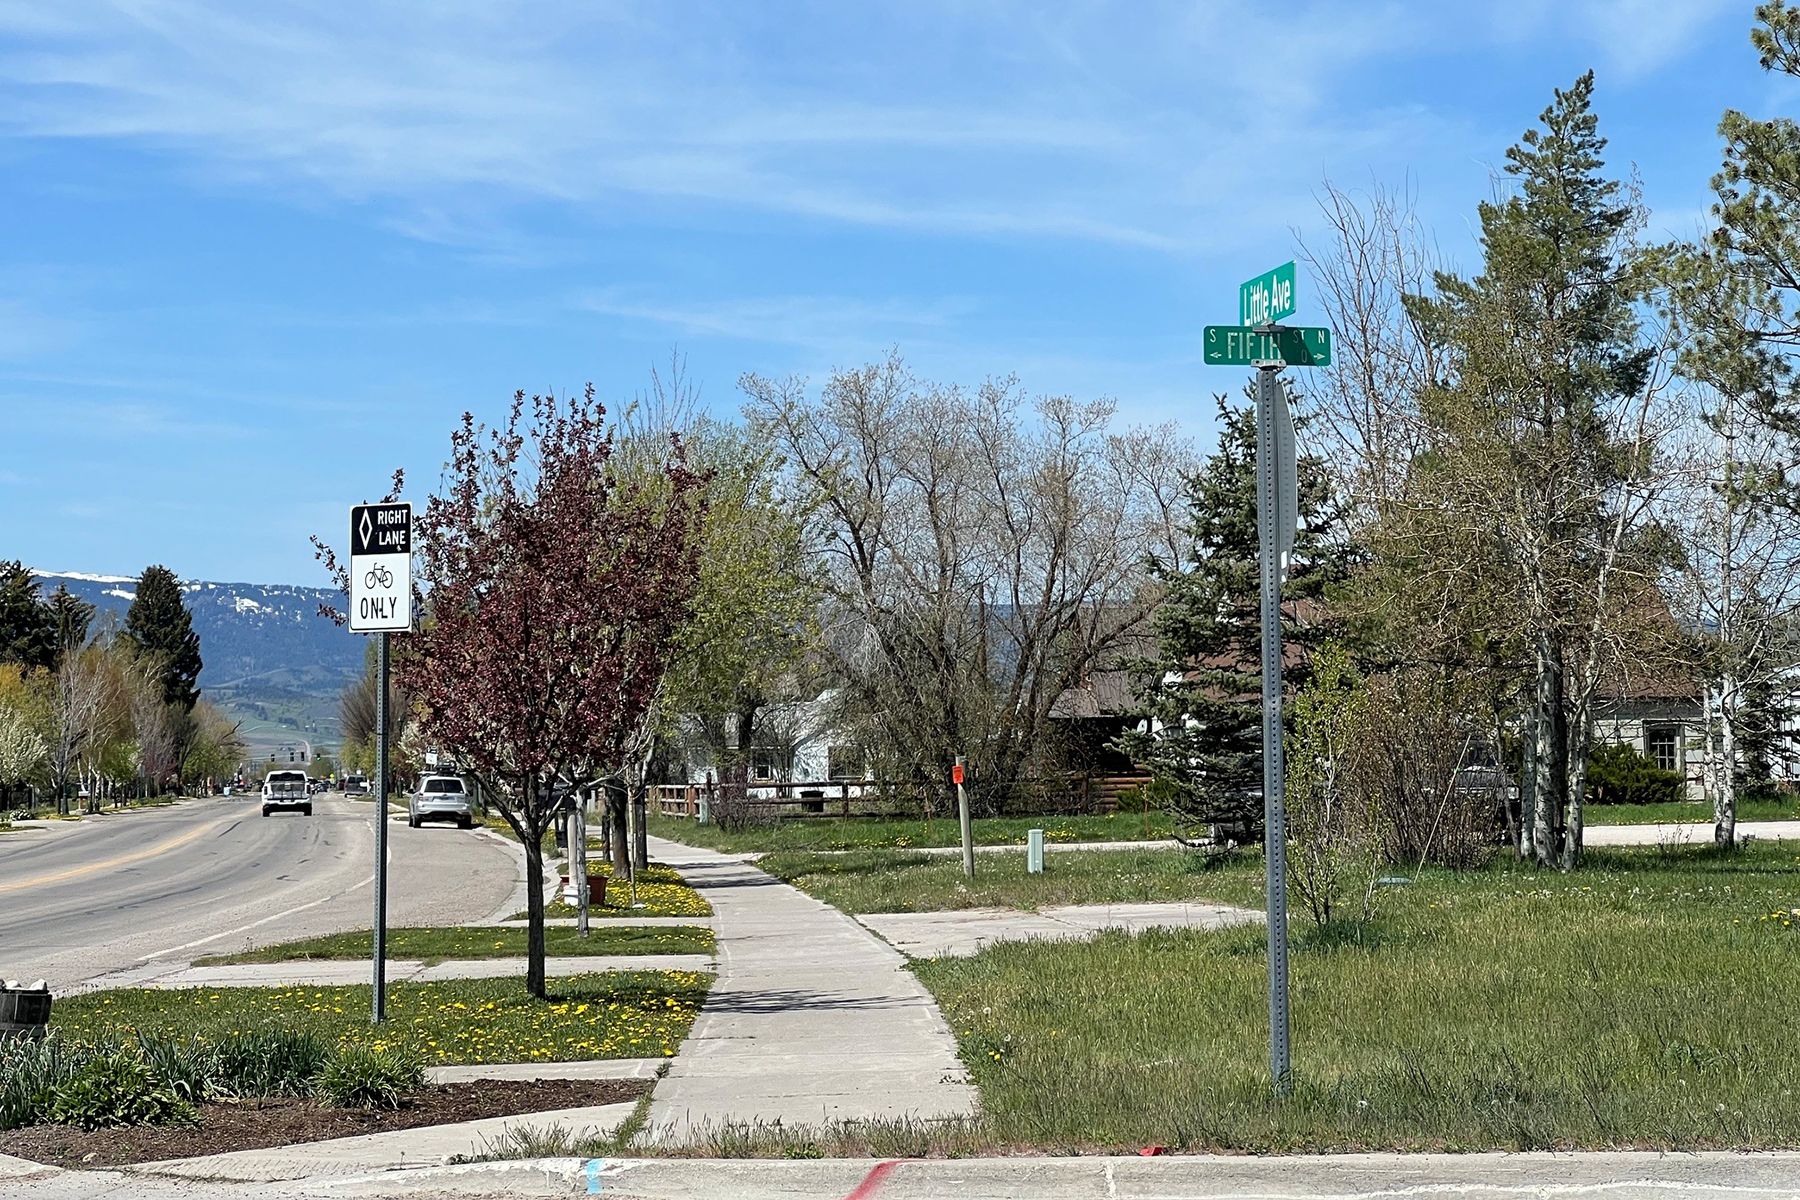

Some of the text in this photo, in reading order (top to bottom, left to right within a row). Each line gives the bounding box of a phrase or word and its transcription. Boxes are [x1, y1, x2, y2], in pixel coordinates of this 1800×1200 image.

[1244, 274, 1291, 327] Little Ave
[1209, 328, 1325, 360] S FIFTH ST N
[377, 509, 408, 525] RIGHT
[378, 530, 406, 545] LANE
[360, 596, 397, 619] ONLY
